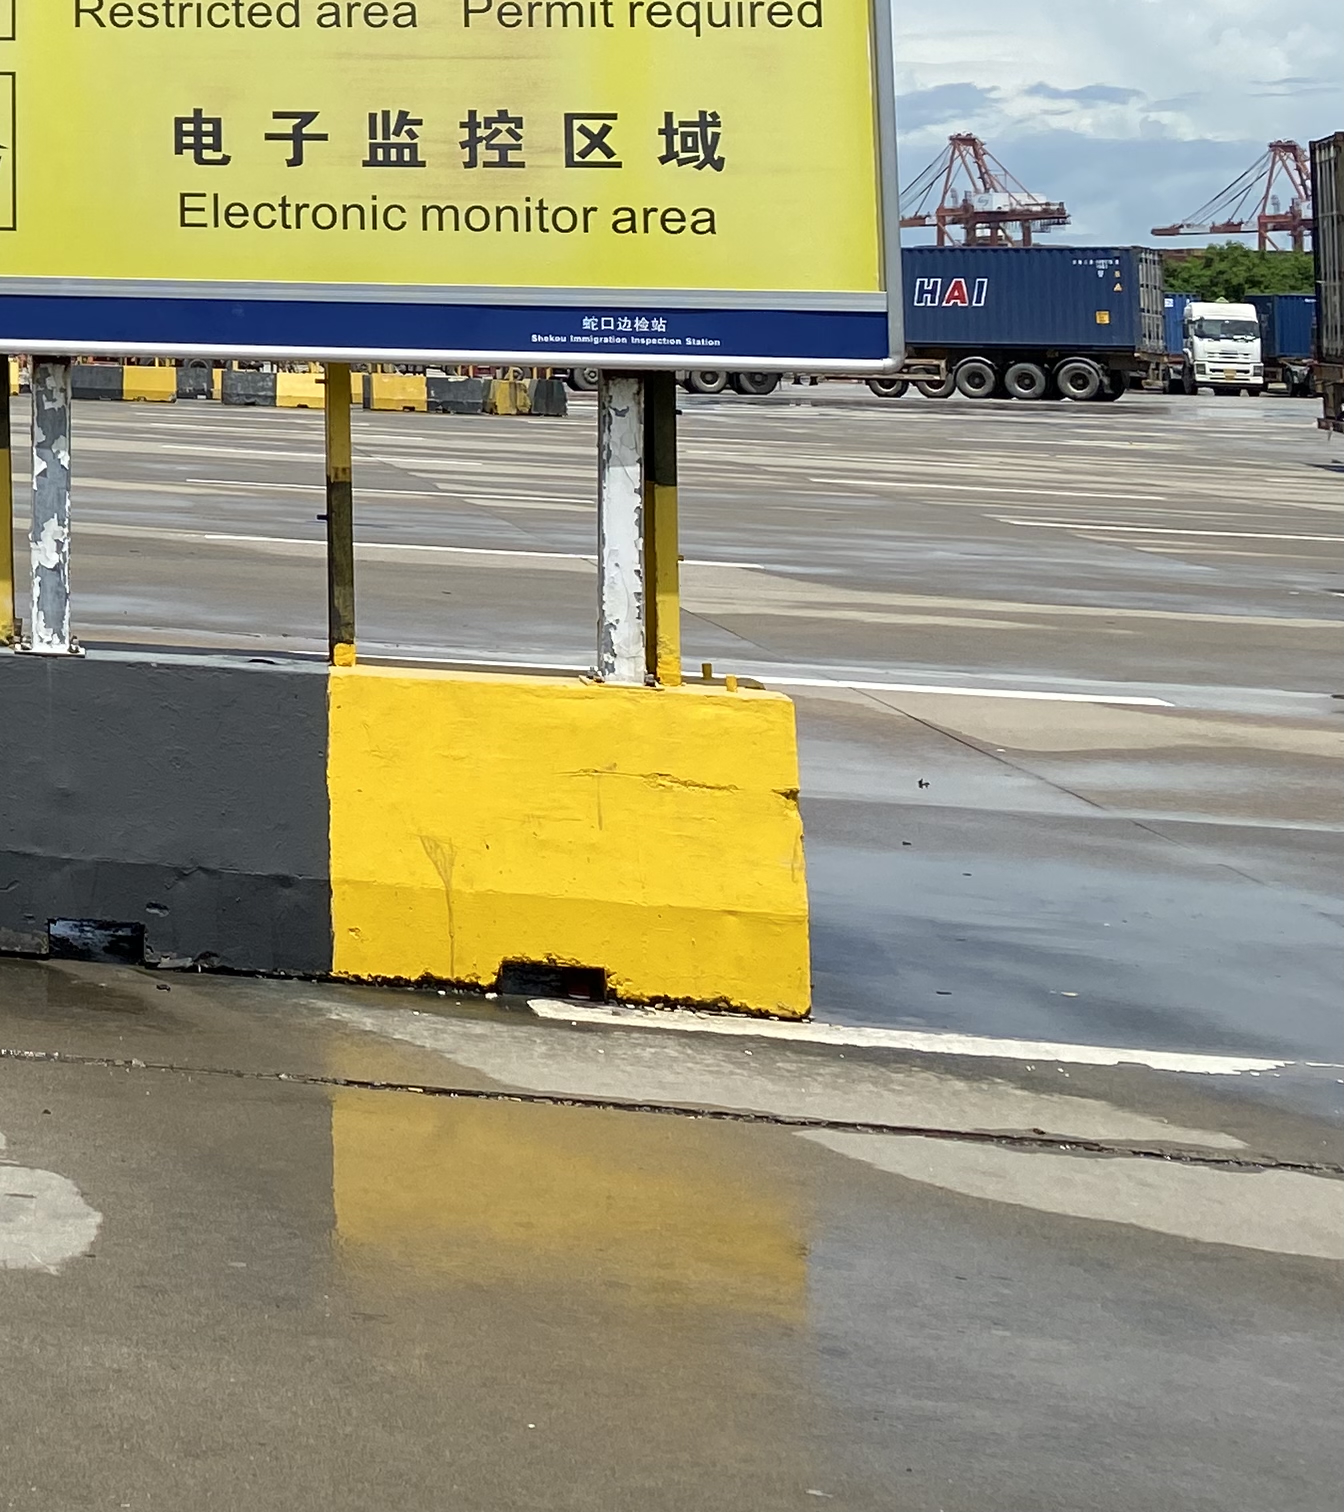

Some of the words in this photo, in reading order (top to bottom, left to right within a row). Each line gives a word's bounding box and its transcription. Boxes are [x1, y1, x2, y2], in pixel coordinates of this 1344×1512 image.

[317, 2, 417, 28] area
[174, 108, 726, 172] 电子监控区域
[180, 193, 406, 231] Electronic
[422, 197, 598, 233] monitor
[612, 207, 716, 235] area
[914, 278, 988, 306] HAI
[582, 316, 667, 332] 蛇口边检站
[570, 335, 627, 344] Immigration
[631, 337, 681, 345] Inspection
